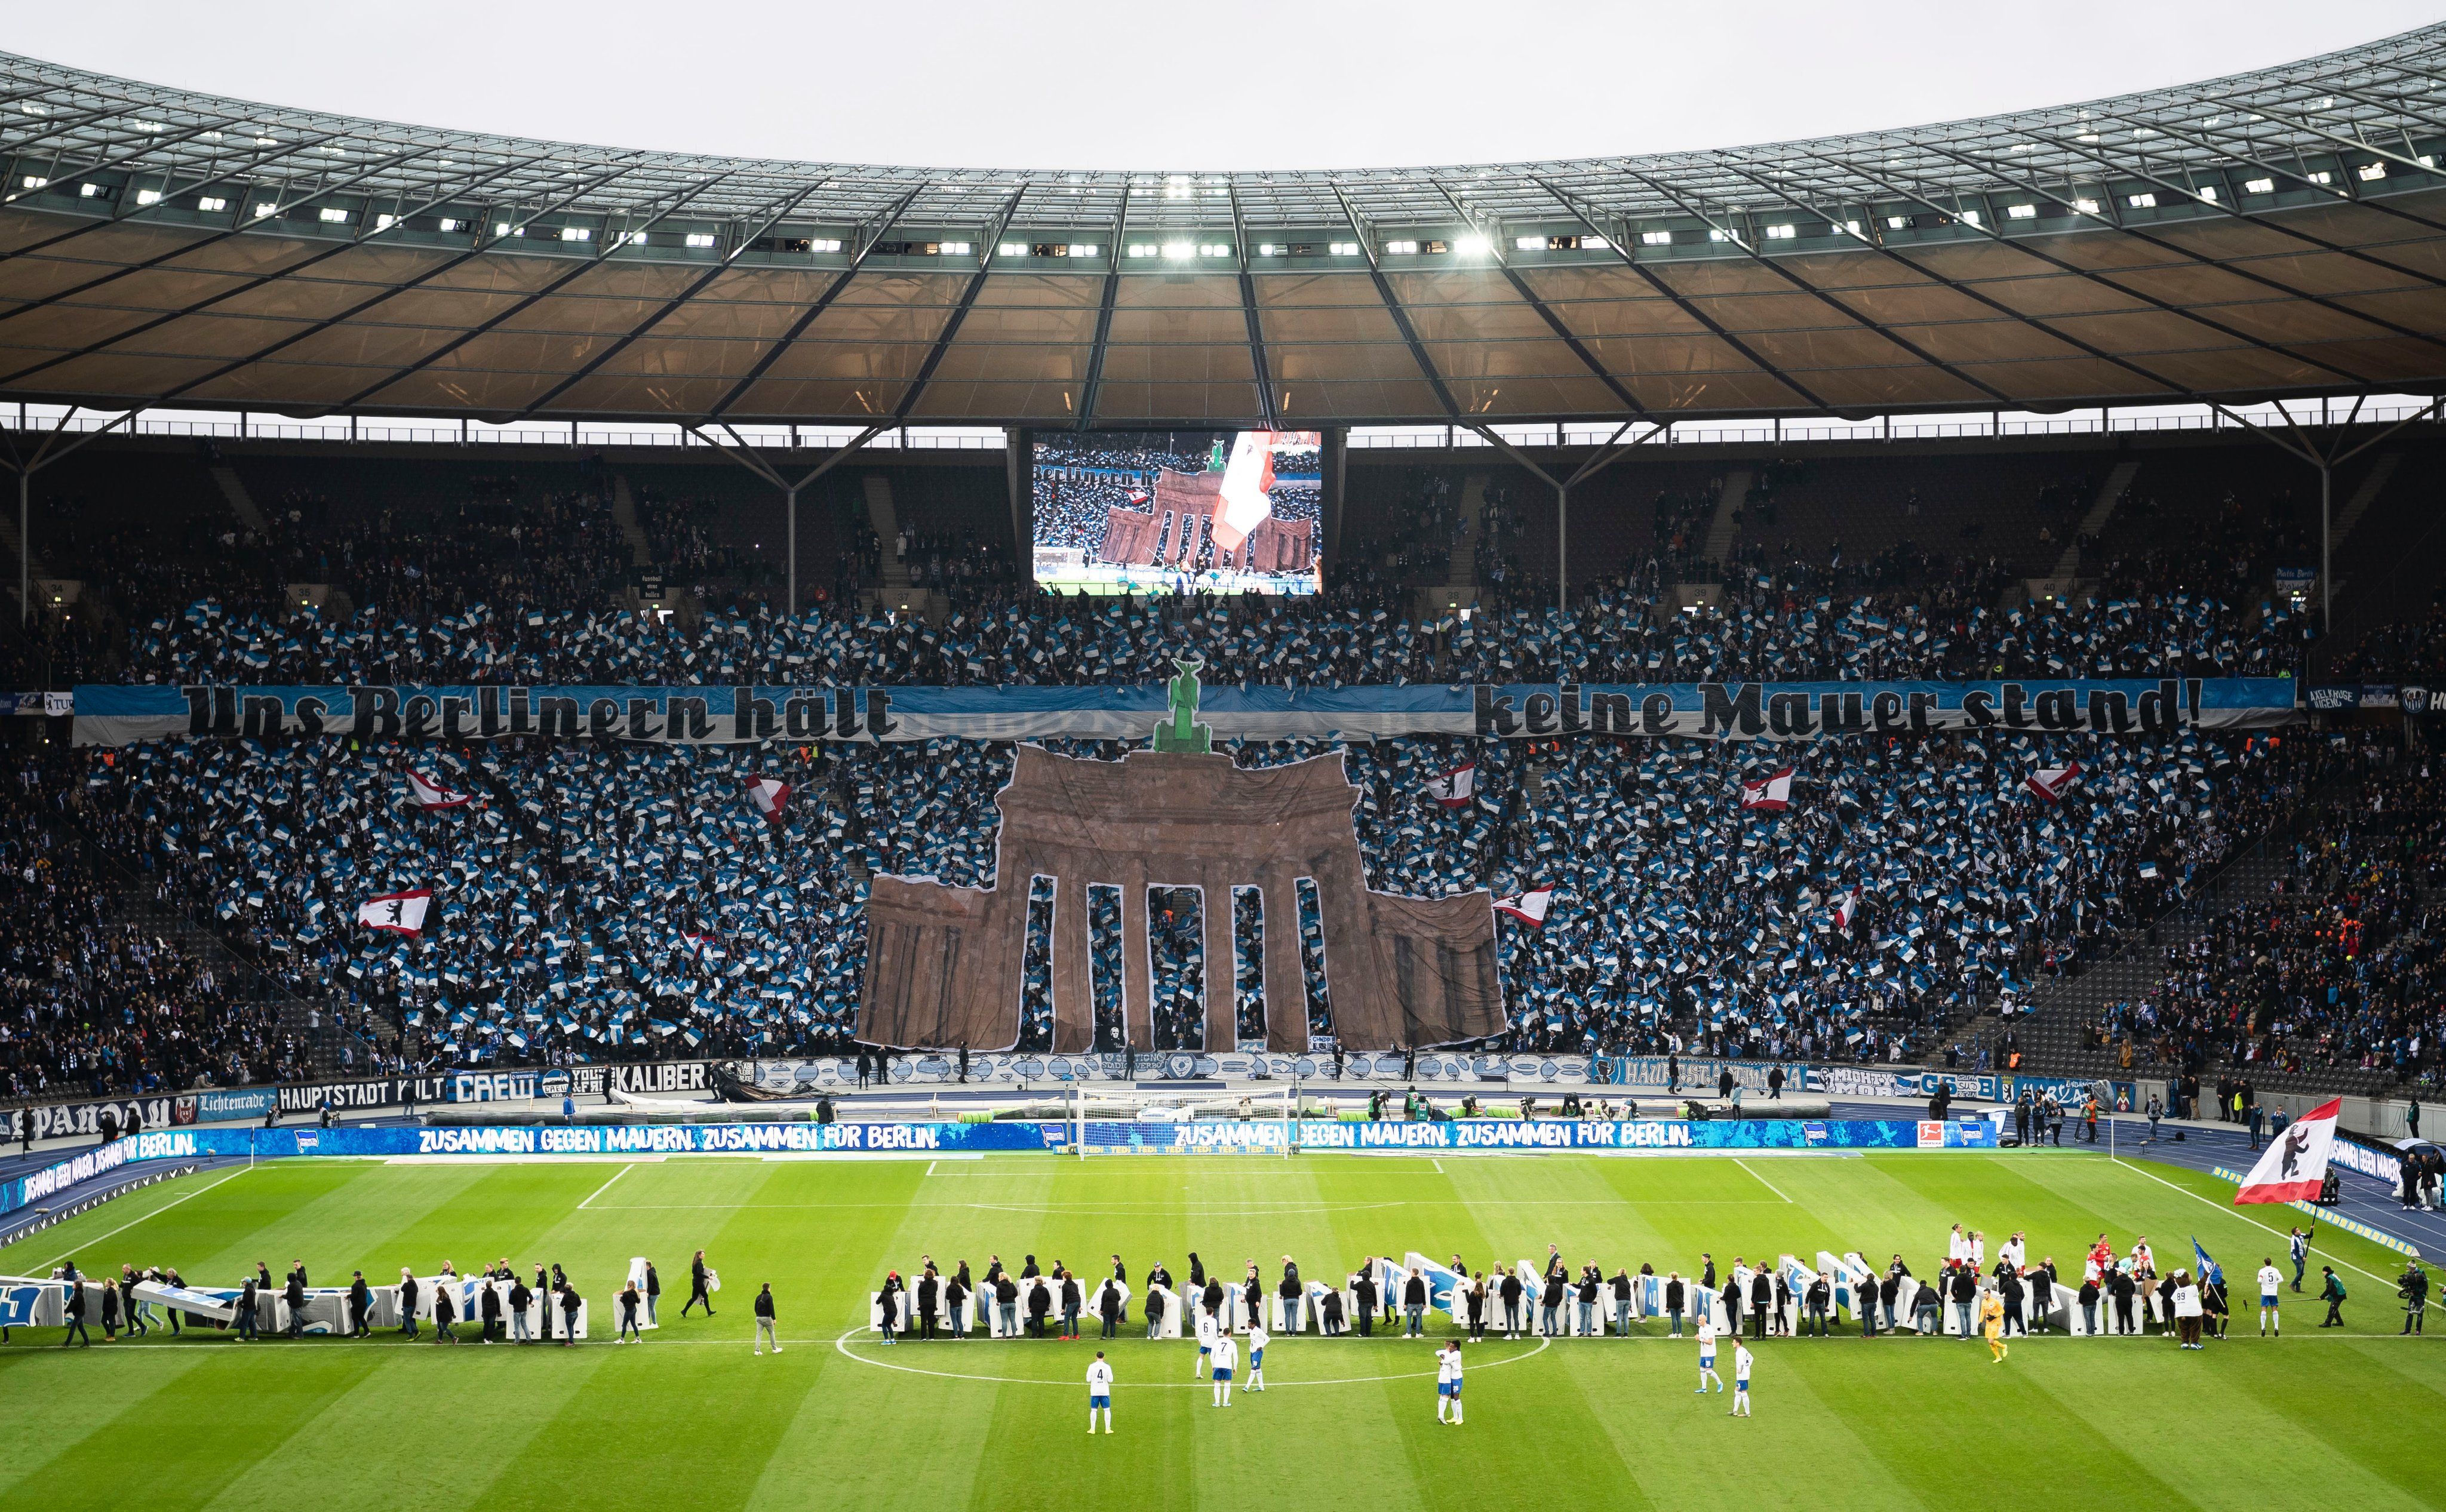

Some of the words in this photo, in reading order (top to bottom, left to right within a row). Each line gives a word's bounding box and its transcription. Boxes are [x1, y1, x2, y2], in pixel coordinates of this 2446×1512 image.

[51, 584, 63, 593] 34
[299, 588, 311, 597] 35
[1695, 588, 1706, 597] 39
[2044, 583, 2055, 592] 40
[898, 593, 909, 601] 37
[1447, 591, 1459, 600] 38
[181, 685, 328, 736] Uns
[346, 685, 717, 739] Berlinern
[733, 686, 899, 739] hält
[1473, 683, 1679, 736] keine
[1697, 683, 1950, 736] Mauer
[1961, 678, 2202, 734] stand!
[616, 1064, 705, 1092] KALIBER
[1833, 1068, 1893, 1086] MIGHTY
[1834, 1081, 1893, 1097] MOB
[280, 1082, 389, 1110] HAUPTSTADT
[200, 1093, 265, 1113] Lichtenrade
[419, 1128, 534, 1153] ZUSAMMEN
[540, 1127, 600, 1152] GEGEN
[607, 1126, 696, 1152] MAUERN.
[703, 1125, 818, 1150] ZUSAMMEN
[823, 1124, 862, 1148] FÜR
[868, 1124, 940, 1149] BERLIN.
[1173, 1123, 1285, 1147] ZUSAMMEN
[1298, 1123, 1354, 1147] GEGEN
[1361, 1121, 1450, 1147] MAUERN.
[1458, 1123, 1571, 1147] ZUSAMMEN
[1578, 1121, 1615, 1145] FÜR
[1621, 1122, 1693, 1147] BERLIN.
[139, 1132, 197, 1157] BERLIN.
[2268, 1272, 2273, 1283] 5
[2177, 1292, 2186, 1301] 89
[1203, 1322, 1208, 1333] 6
[1221, 1342, 1227, 1353] 7
[1096, 1369, 1103, 1380] 4
